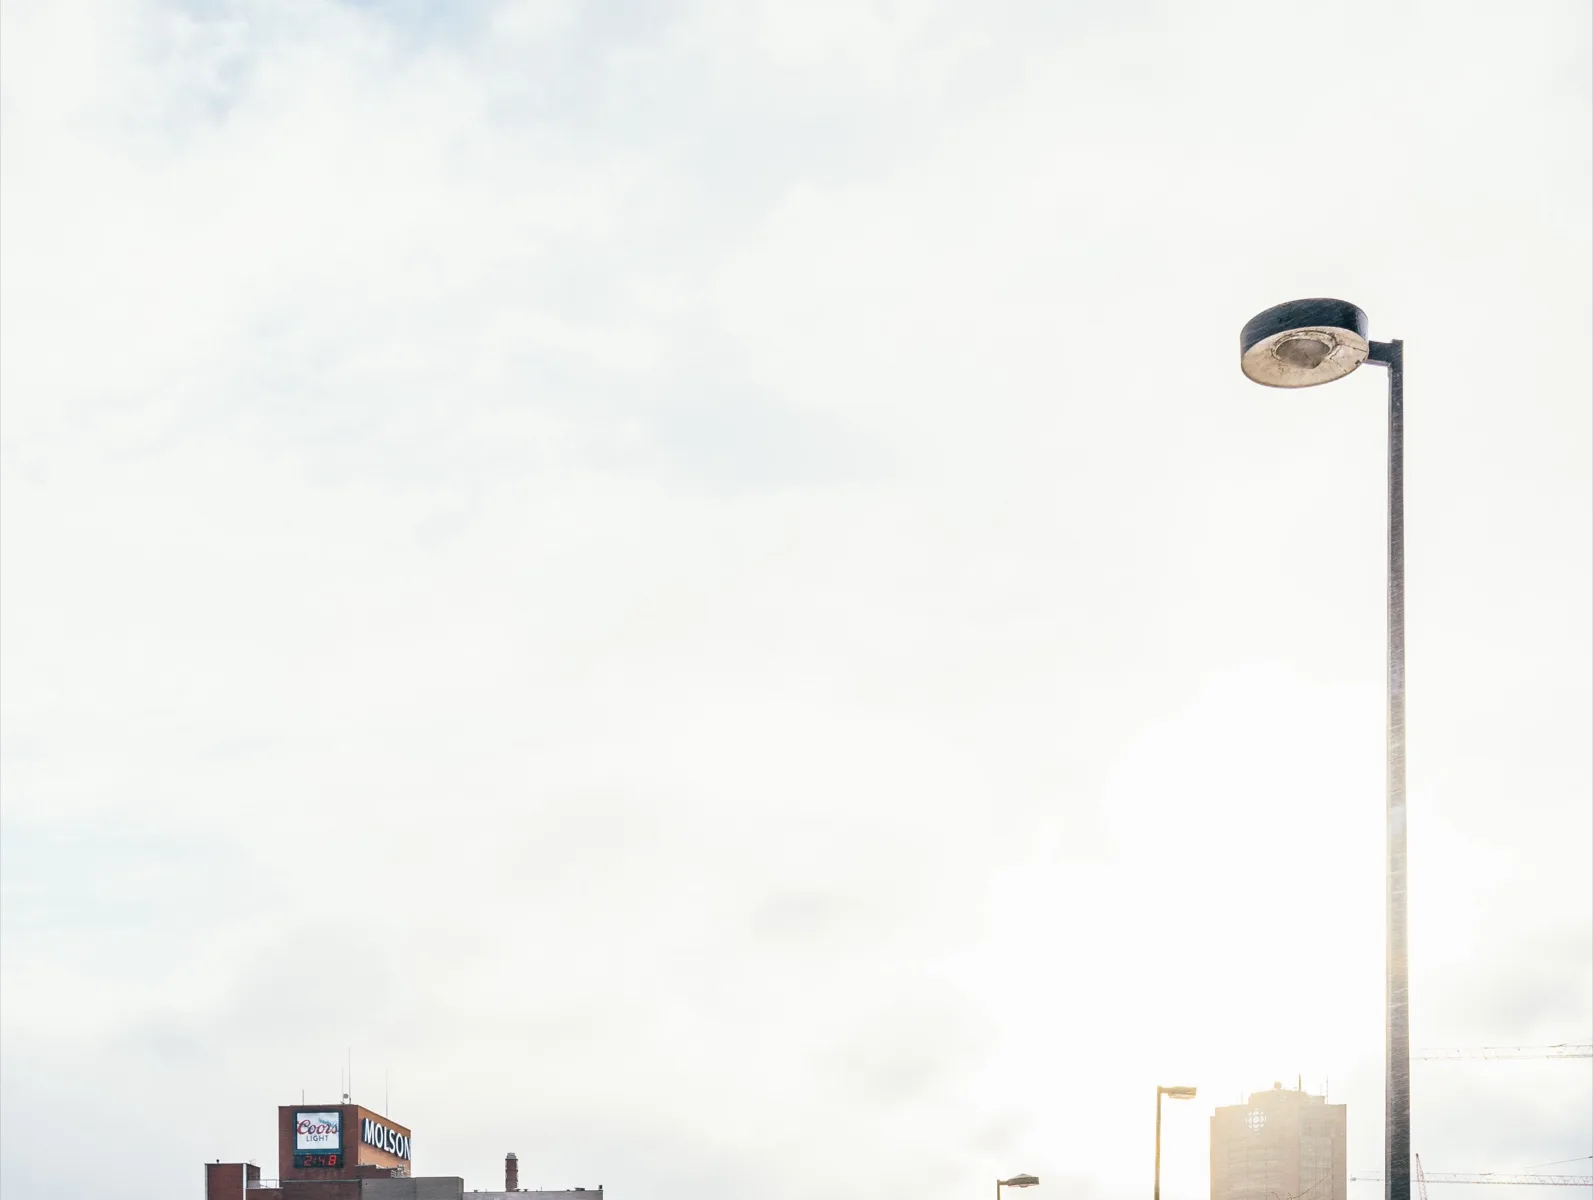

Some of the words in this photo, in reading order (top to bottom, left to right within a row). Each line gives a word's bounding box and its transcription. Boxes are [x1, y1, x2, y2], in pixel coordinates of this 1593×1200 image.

[297, 1119, 339, 1135] Coors
[364, 1117, 410, 1160] MOLSON
[304, 1155, 337, 1166] 2:48
